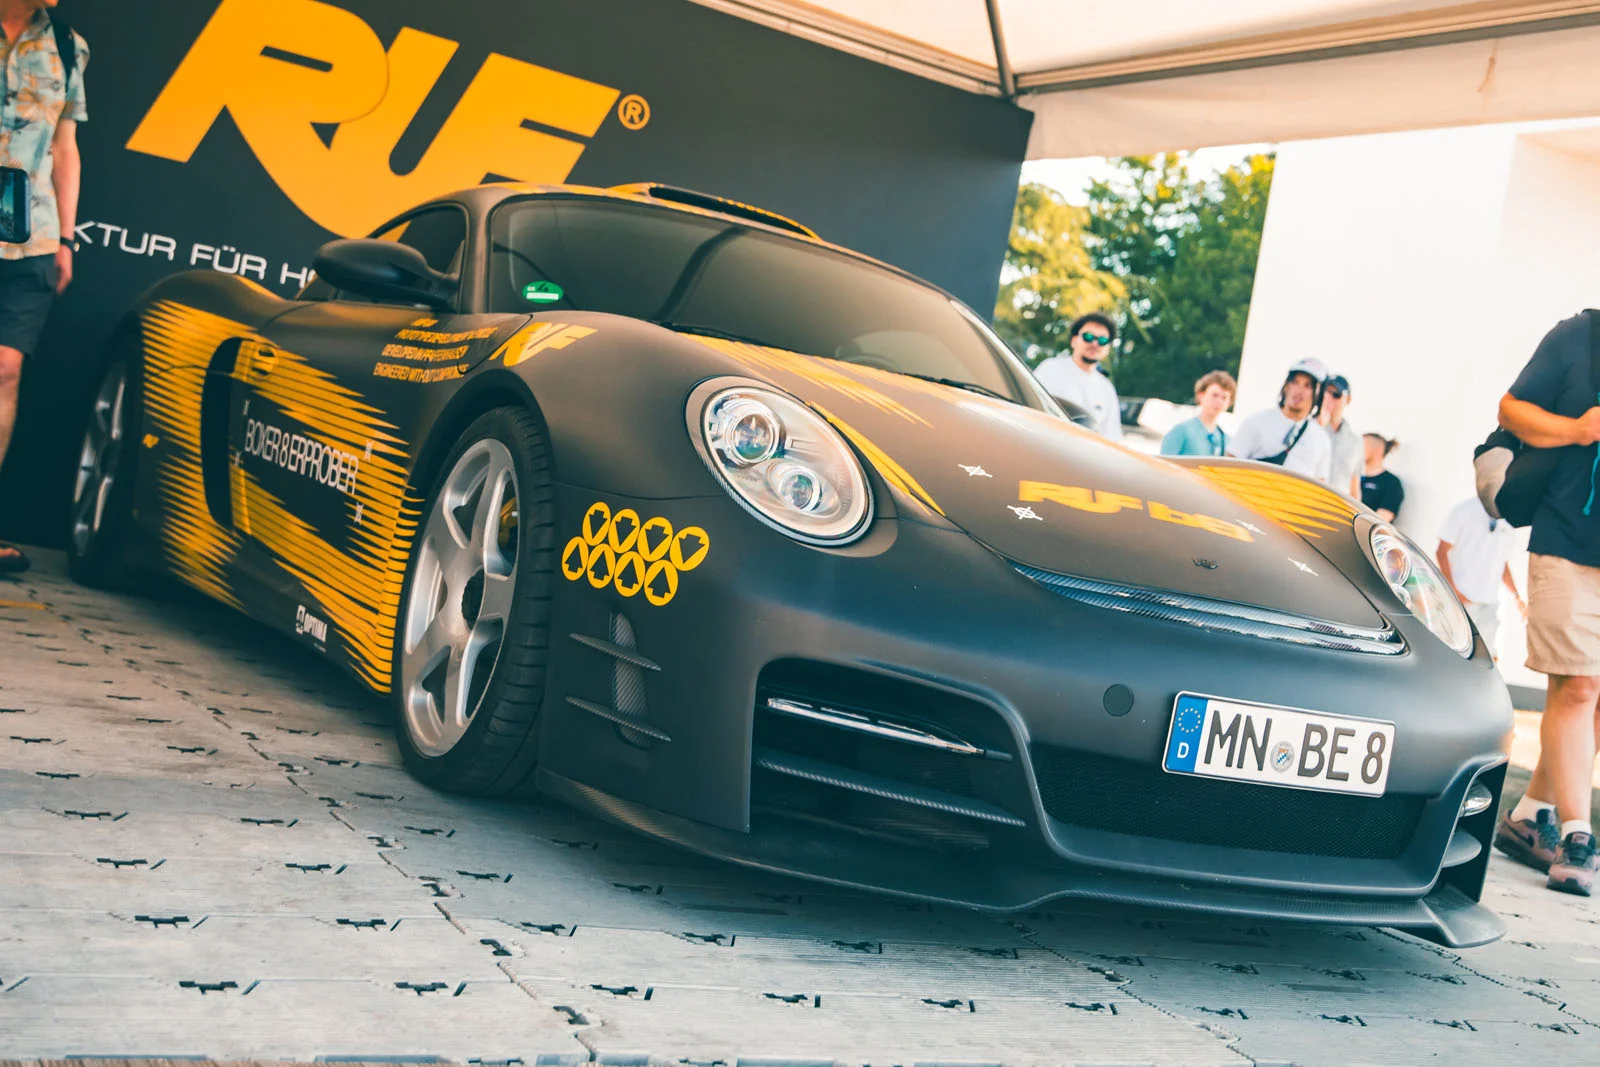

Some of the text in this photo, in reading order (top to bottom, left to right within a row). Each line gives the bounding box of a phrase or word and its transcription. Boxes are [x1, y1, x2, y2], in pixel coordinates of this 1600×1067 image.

[125, 0, 620, 242] RUF
[190, 243, 267, 280] FÜR
[280, 262, 316, 289] H
[245, 418, 282, 464] BOXER
[288, 434, 359, 495] ERPROBER
[1019, 480, 1143, 513] RUF
[1177, 742, 1189, 759] D
[1204, 710, 1386, 784] MN BE 8
